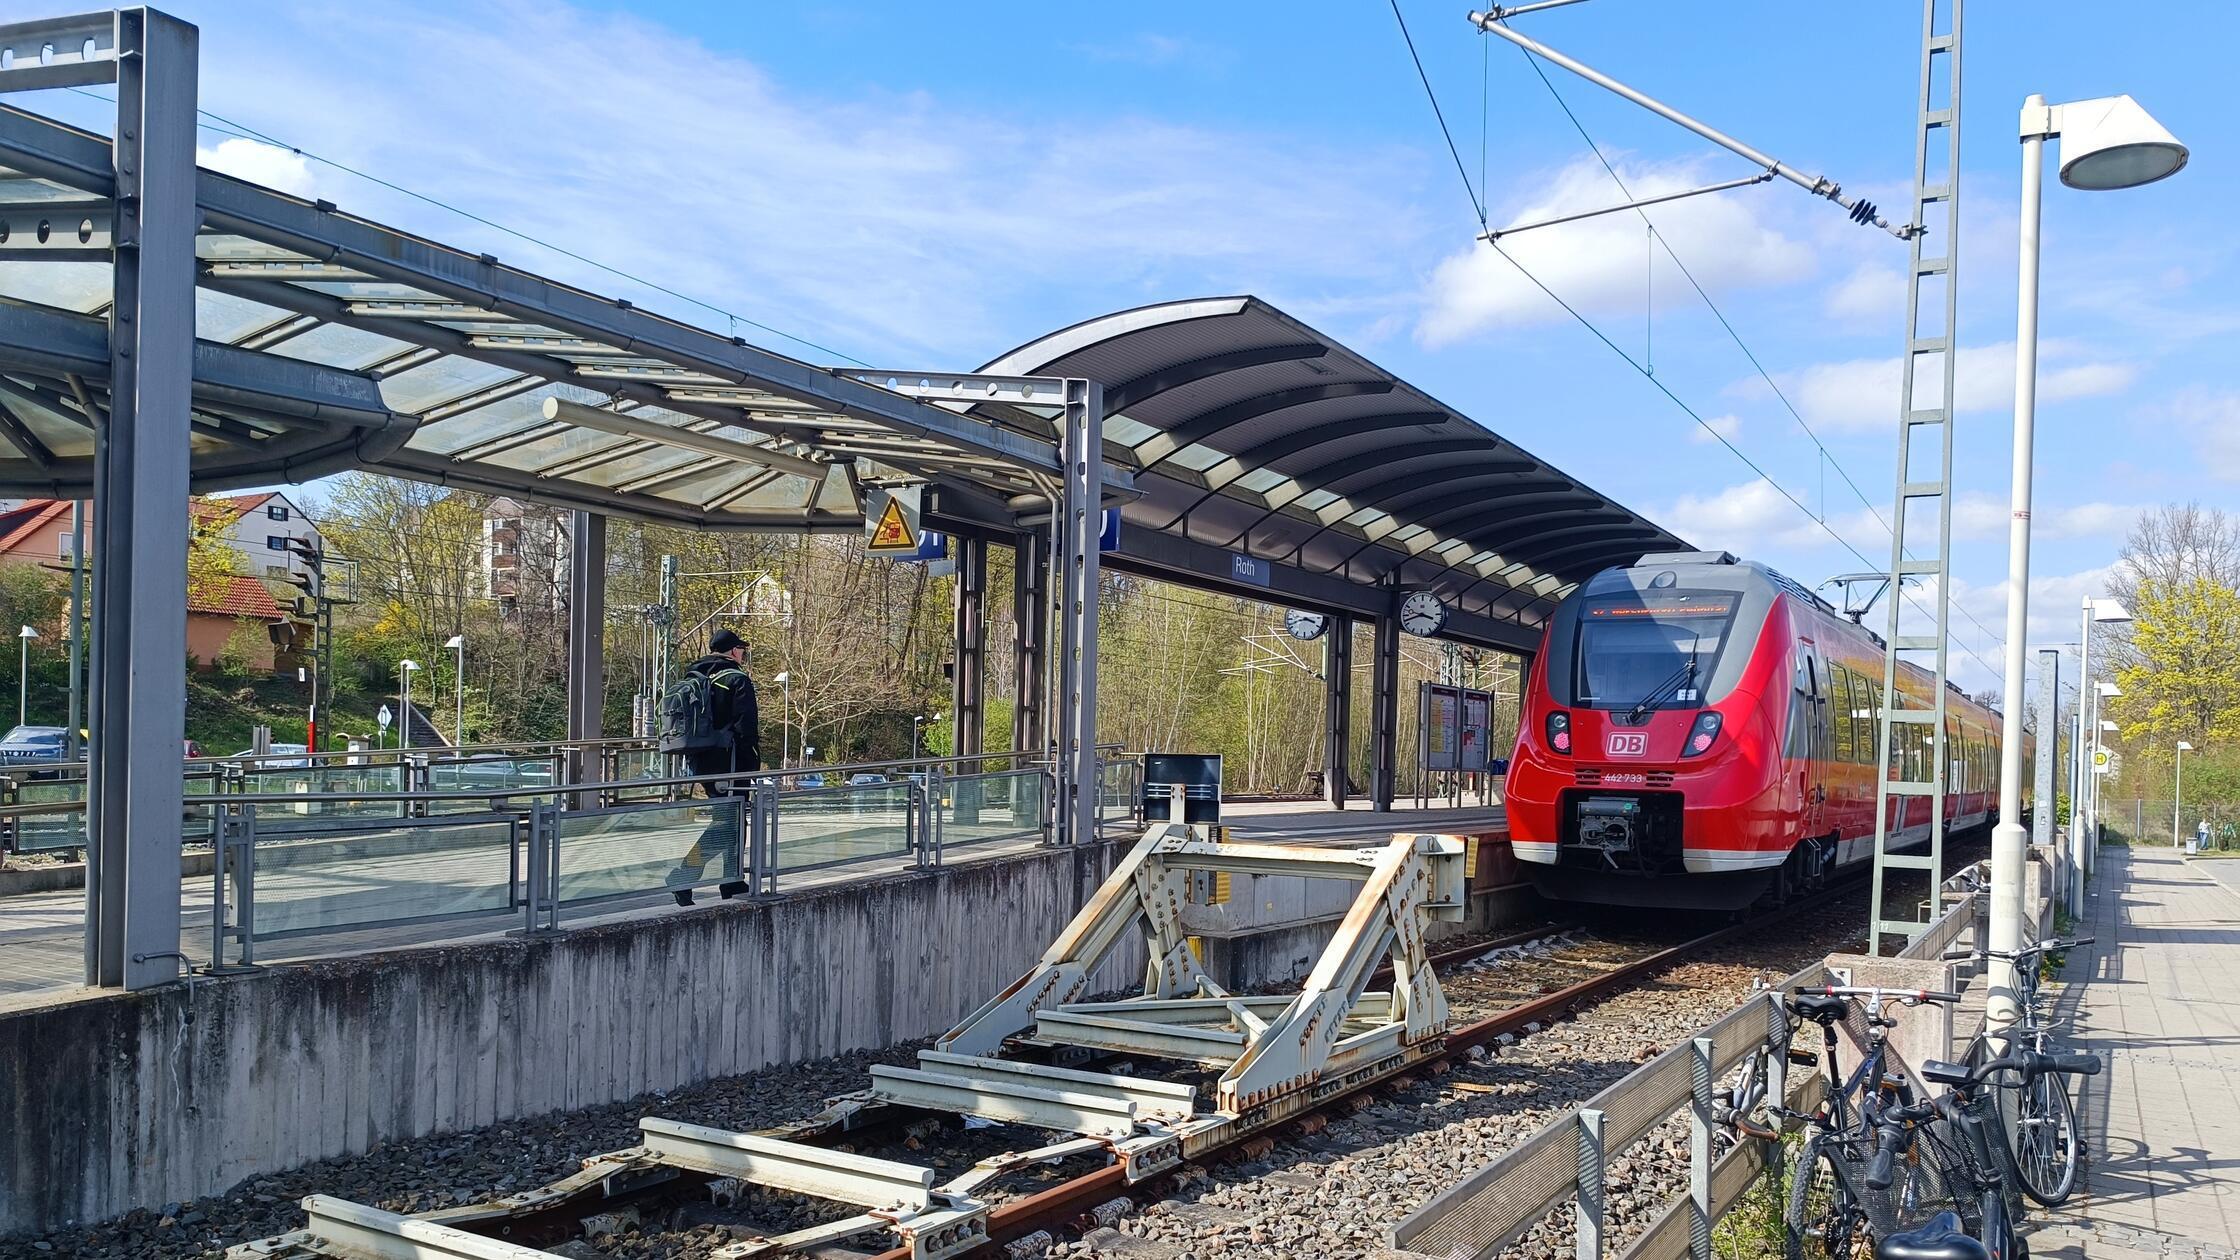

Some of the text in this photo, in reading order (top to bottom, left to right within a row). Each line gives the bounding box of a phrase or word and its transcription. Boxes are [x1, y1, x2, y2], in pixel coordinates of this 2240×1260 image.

[1235, 556, 1255, 577] Roth
[1611, 736, 1642, 752] DB
[1604, 773, 1643, 783] 442 733
